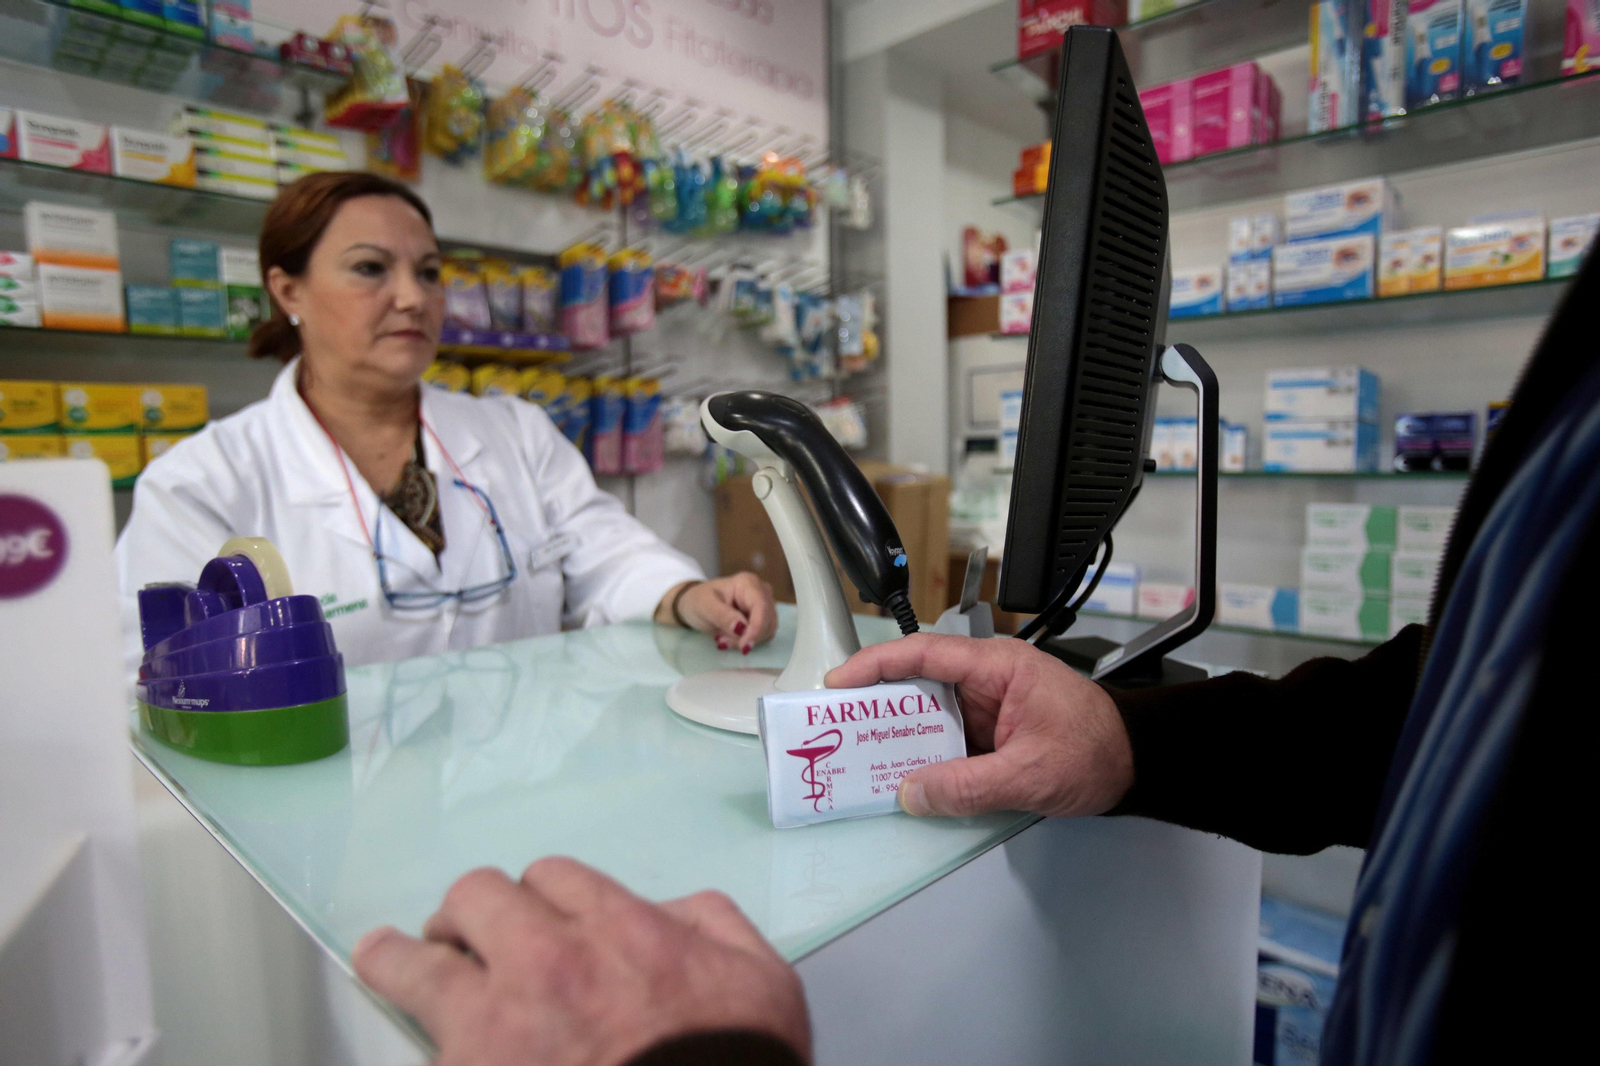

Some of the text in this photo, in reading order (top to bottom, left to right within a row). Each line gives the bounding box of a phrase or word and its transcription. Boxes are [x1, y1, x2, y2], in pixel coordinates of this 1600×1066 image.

[805, 692, 942, 726] FARMACIA
[856, 723, 944, 746] José Miguel Senabre Carmena
[870, 761, 888, 772] Avda.
[890, 760, 905, 769] Juan
[906, 756, 927, 767] Carlos
[871, 772, 891, 783] 11007
[871, 783, 885, 794] Tel.:
